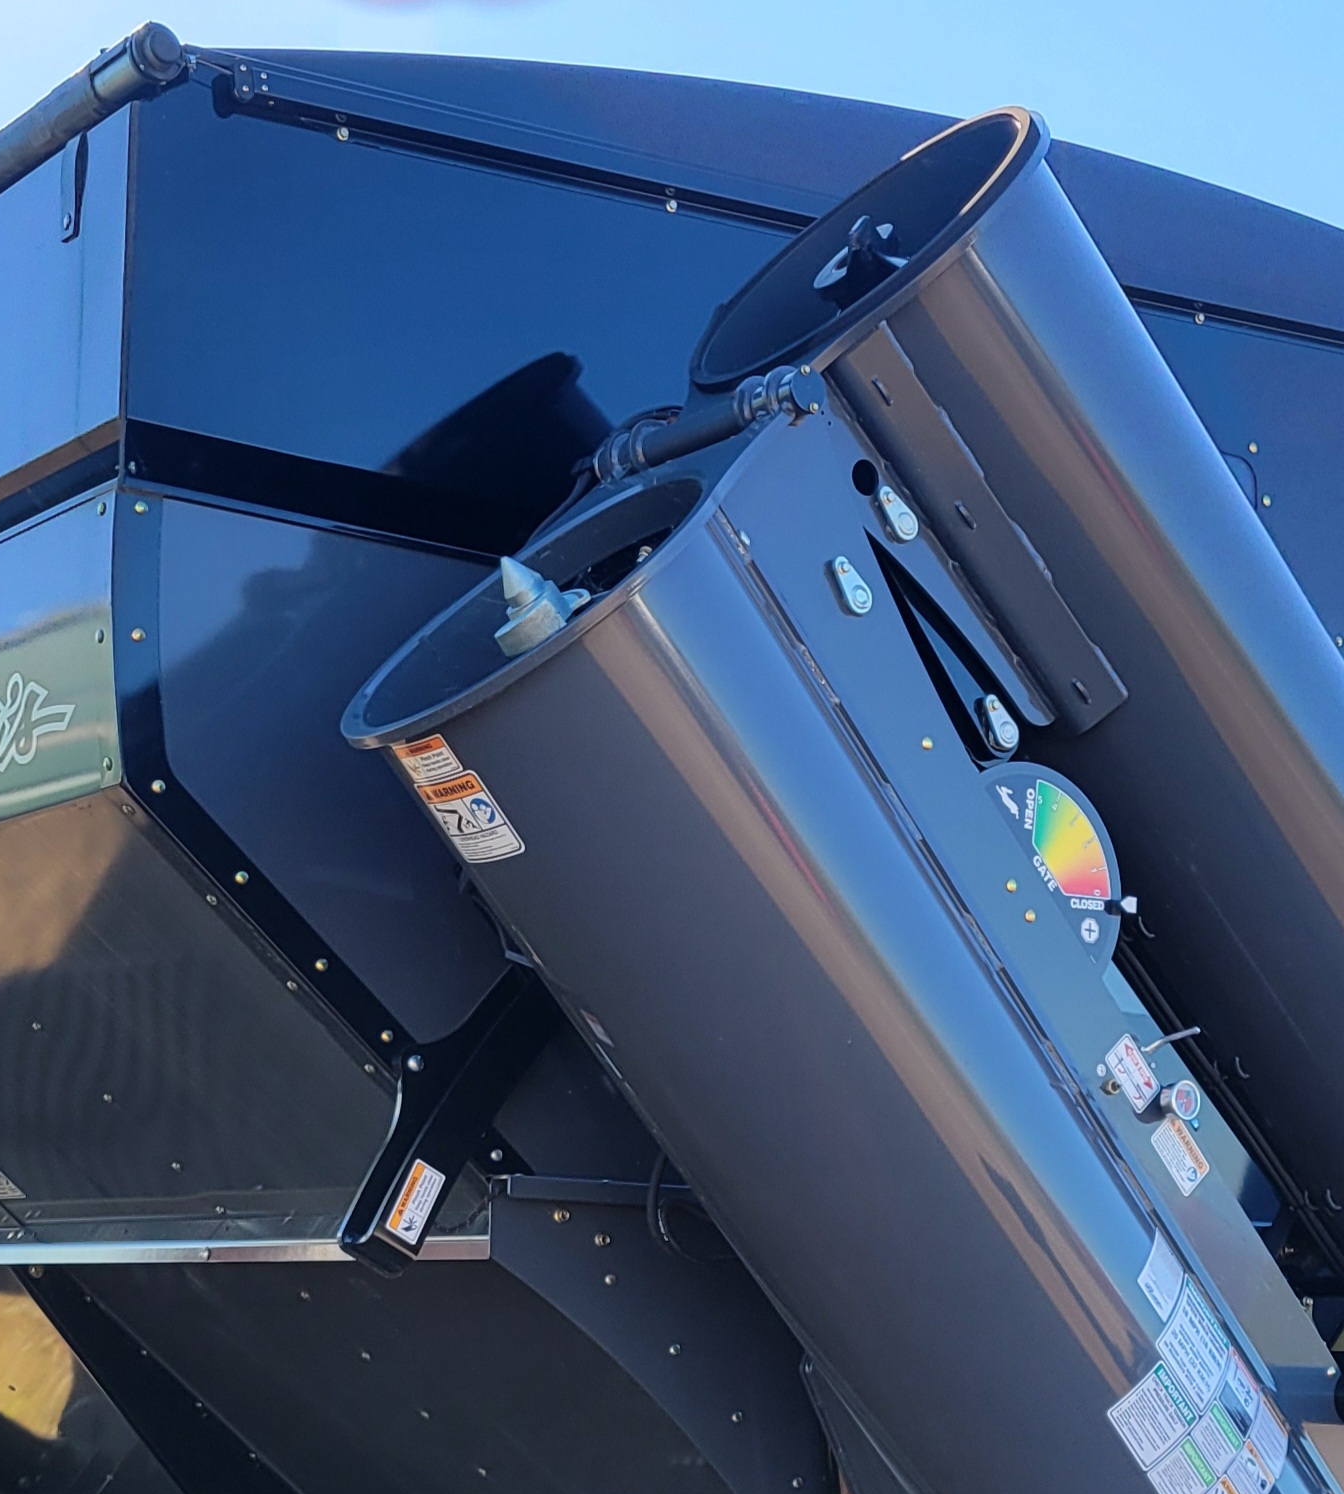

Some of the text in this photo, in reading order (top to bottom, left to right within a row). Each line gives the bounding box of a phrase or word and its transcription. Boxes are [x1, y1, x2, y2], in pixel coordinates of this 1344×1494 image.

[433, 780, 475, 798] WARNING
[1023, 788, 1035, 830] OPEN
[1032, 855, 1058, 892] GATE
[1070, 898, 1105, 911] CLOSED
[1176, 1126, 1204, 1170] WARNING
[1158, 1368, 1193, 1421] IMPORTANT
